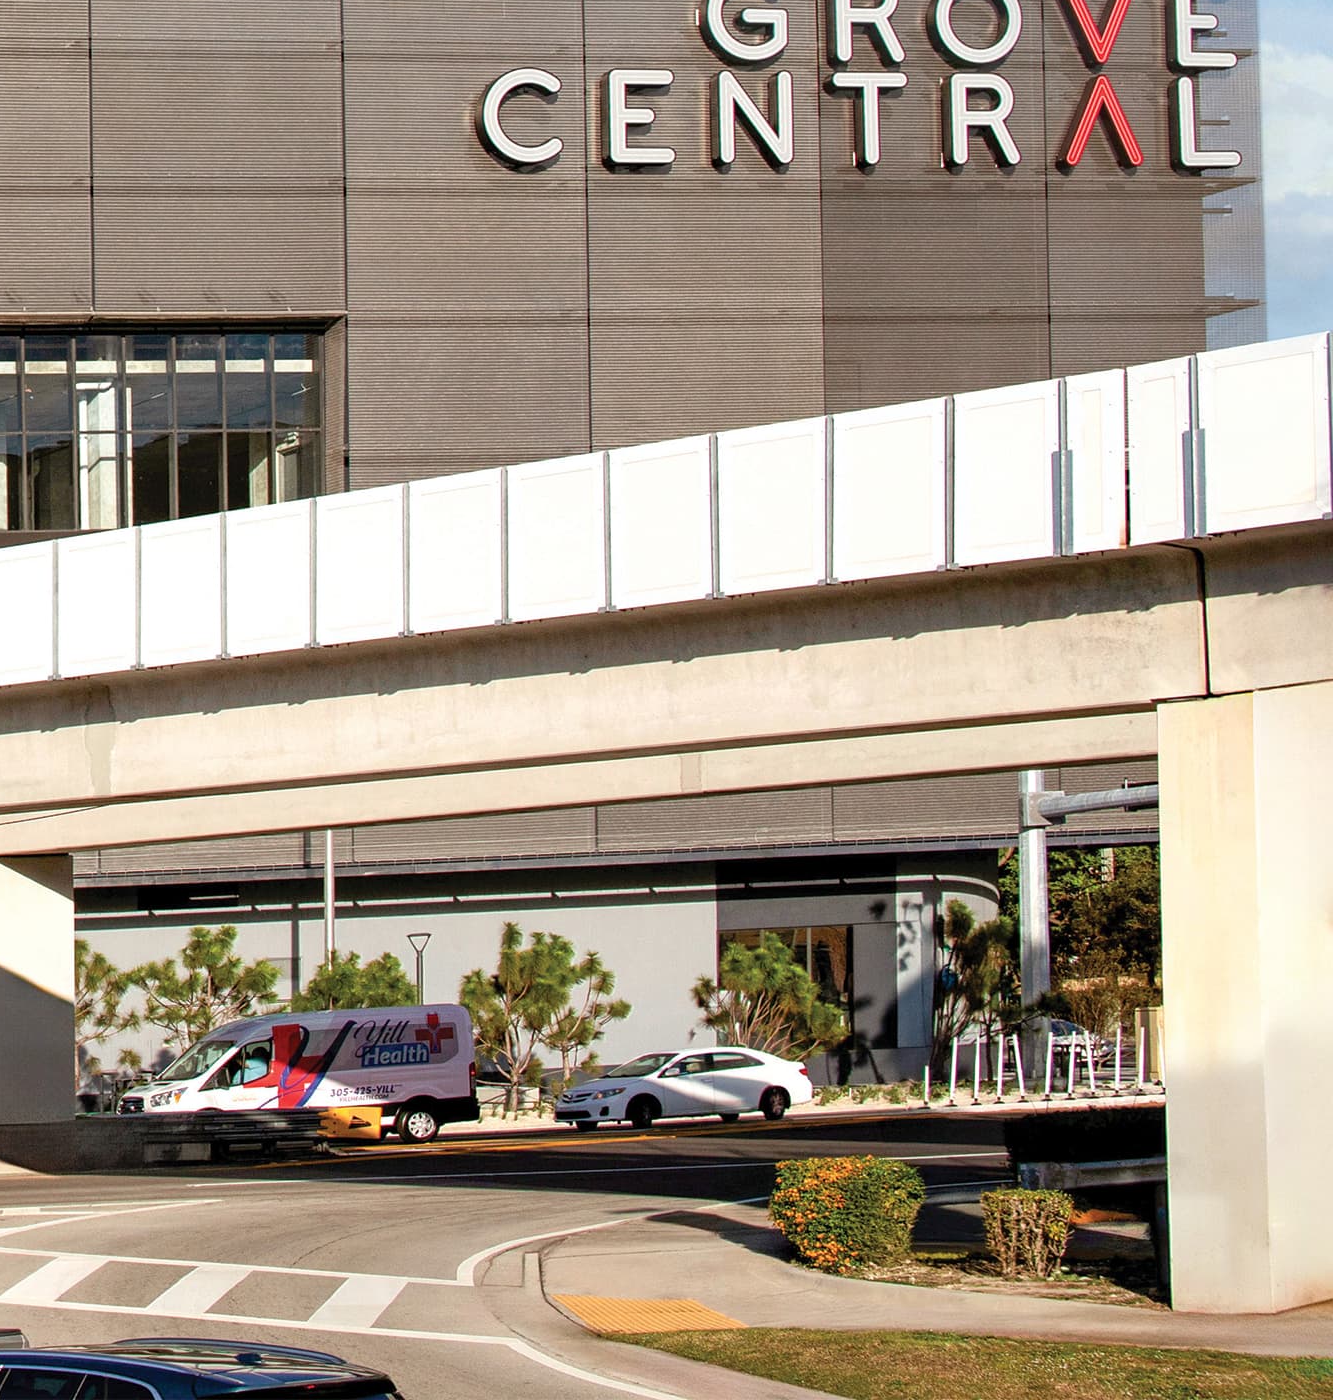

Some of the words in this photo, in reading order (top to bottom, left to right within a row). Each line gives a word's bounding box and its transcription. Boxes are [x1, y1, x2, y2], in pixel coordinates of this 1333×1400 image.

[477, 67, 1243, 171] CENTRAL
[363, 1044, 429, 1066] Health
[330, 1084, 396, 1098] 305-425-YILL
